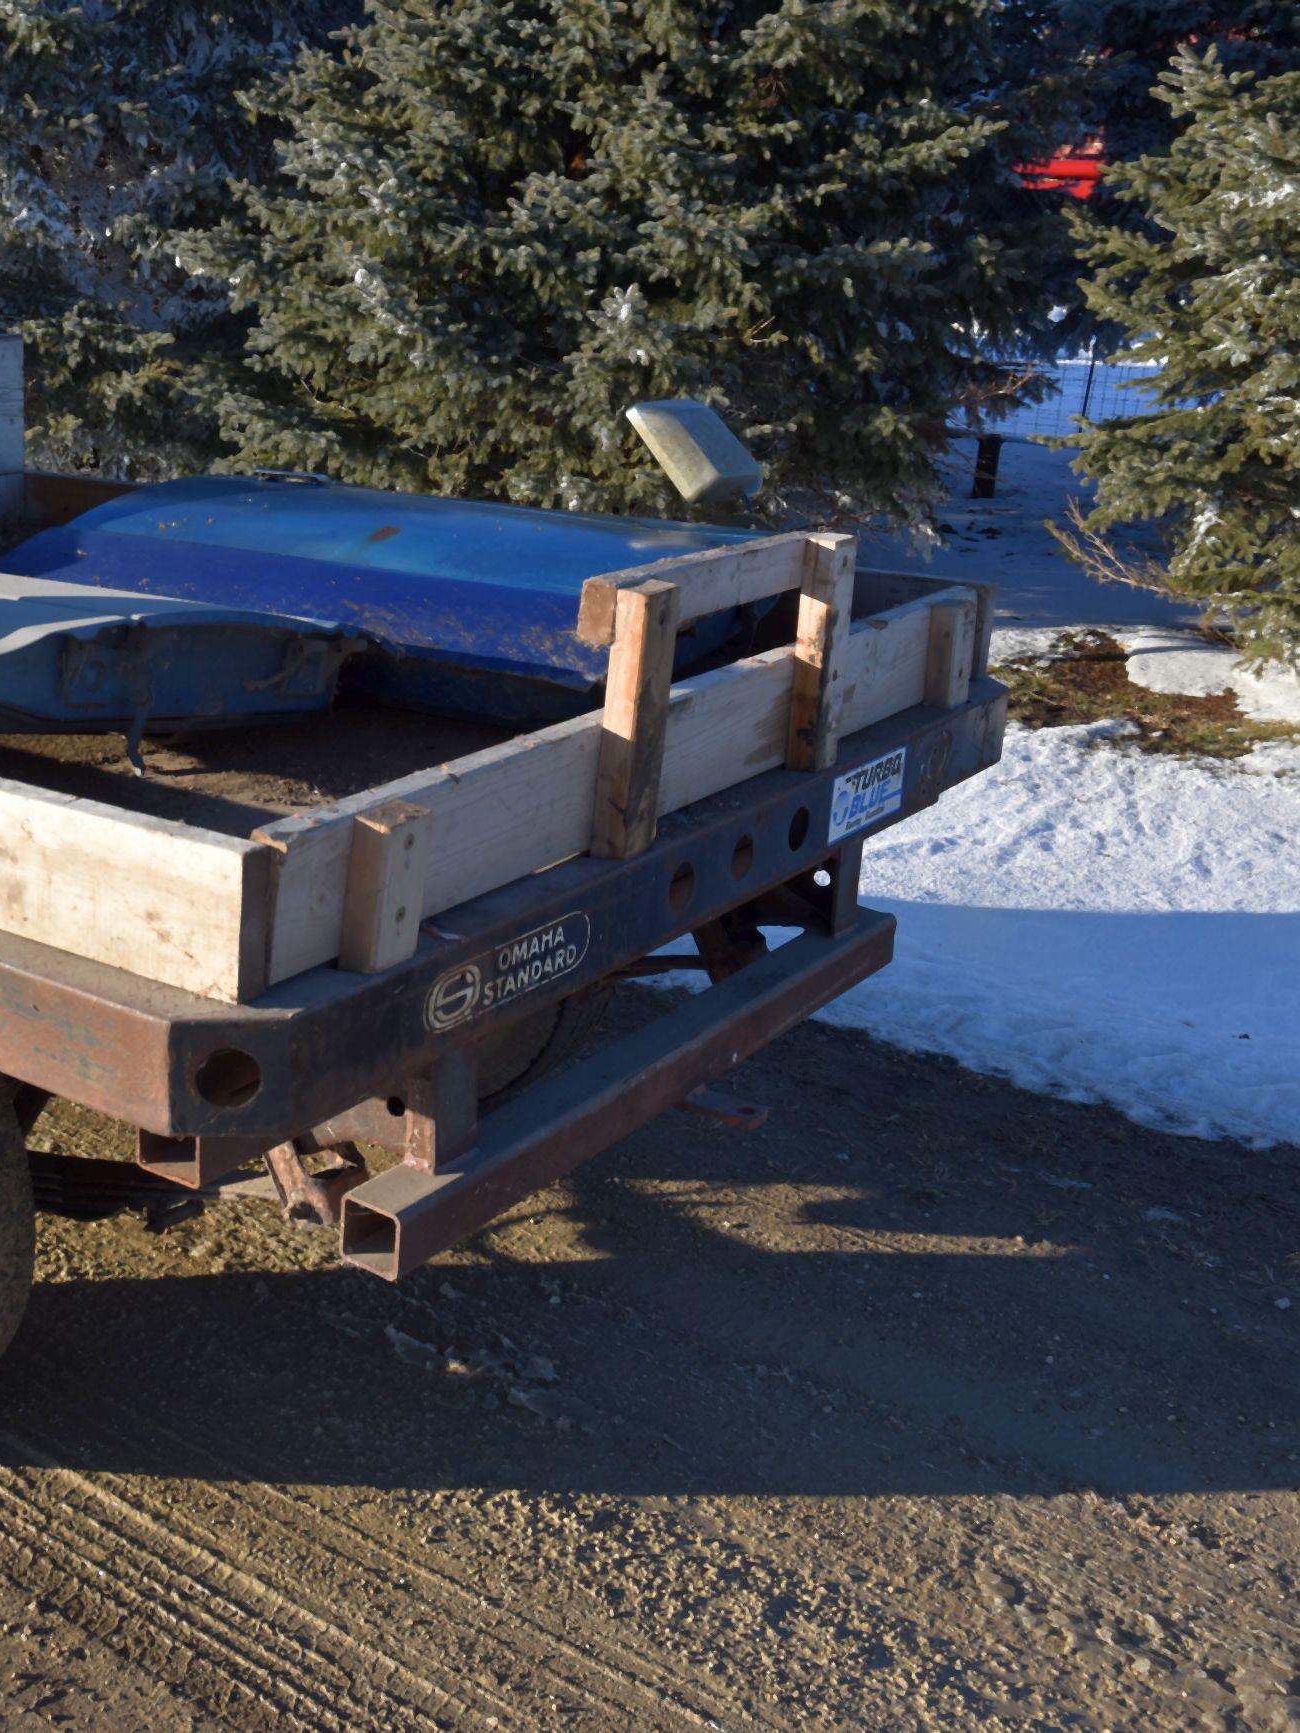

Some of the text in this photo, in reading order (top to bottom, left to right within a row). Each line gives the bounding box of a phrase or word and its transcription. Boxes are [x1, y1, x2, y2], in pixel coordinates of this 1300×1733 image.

[846, 753, 903, 795] TURBO
[848, 779, 892, 820] BLUE
[499, 924, 565, 971] OMAHA
[482, 944, 578, 1006] STANDARD
